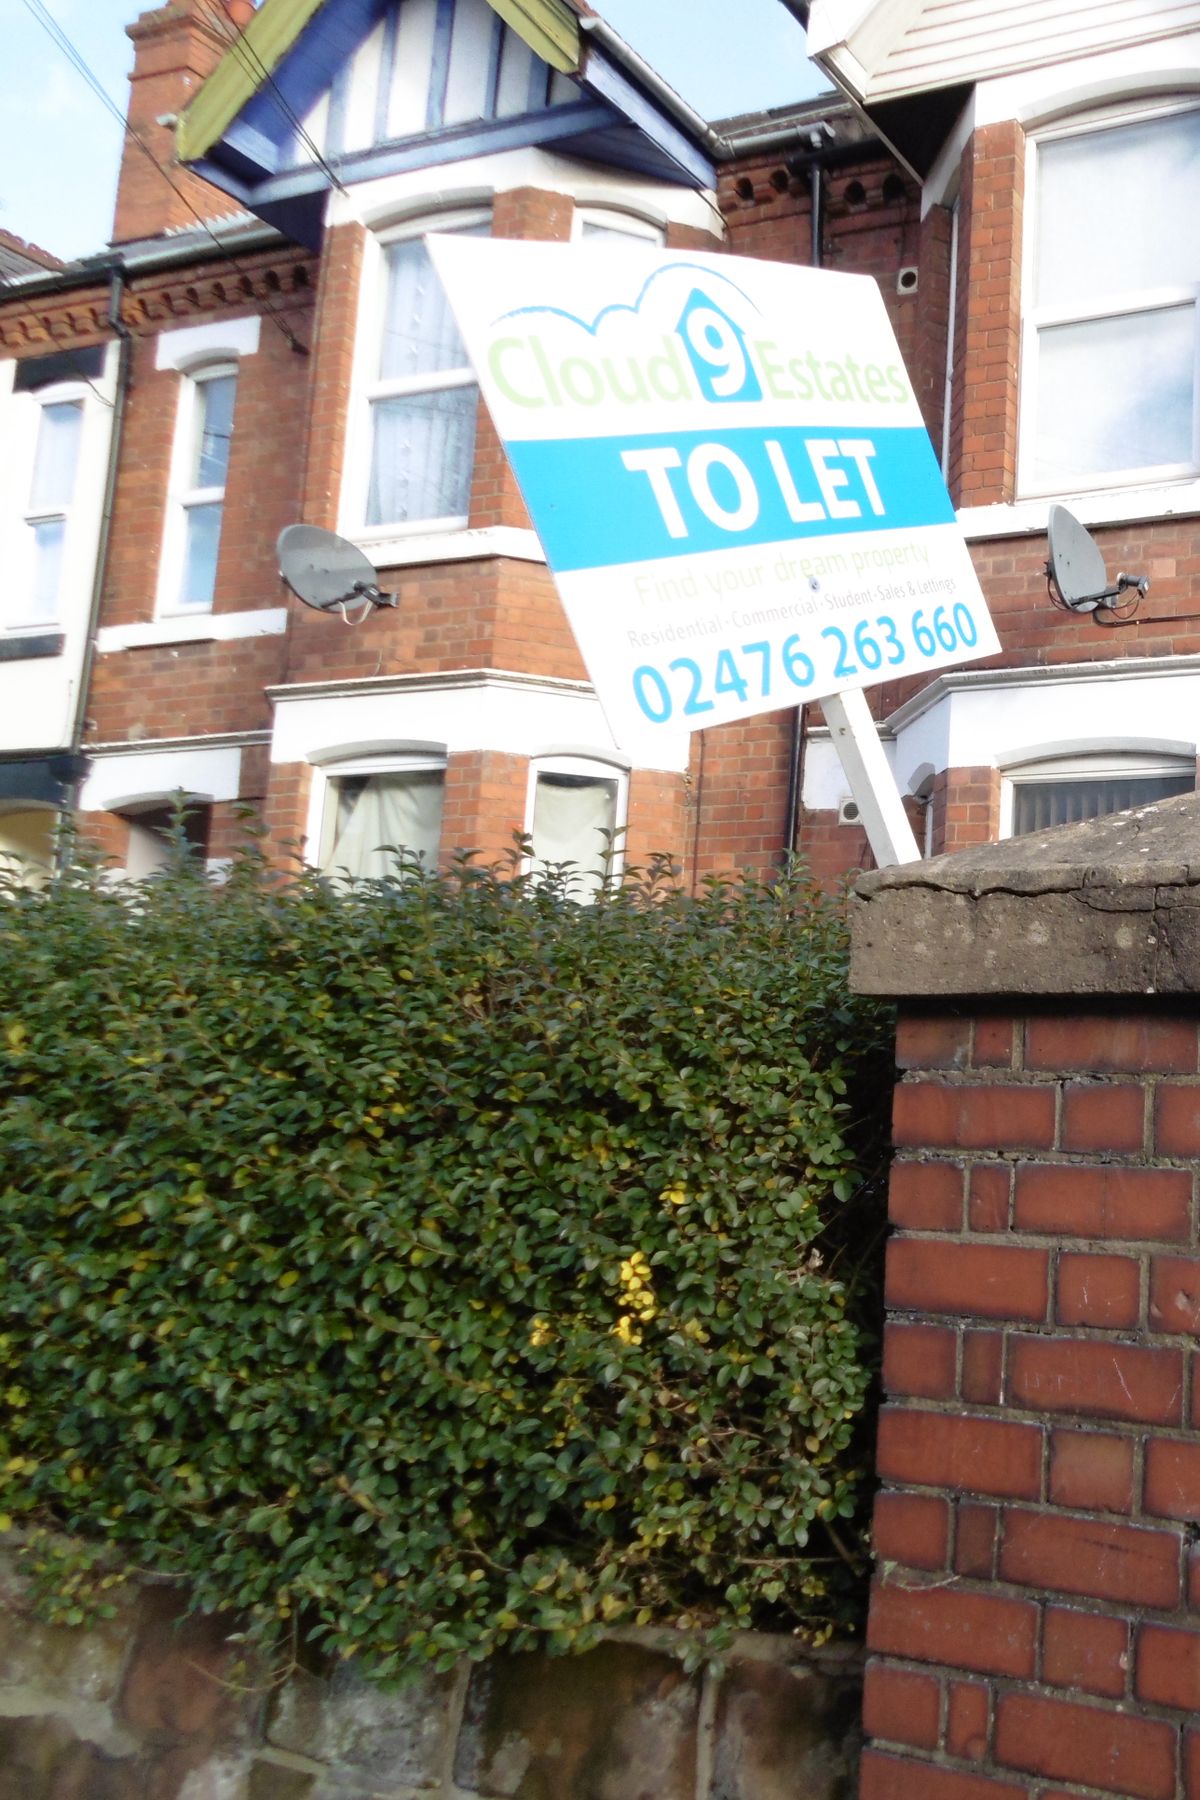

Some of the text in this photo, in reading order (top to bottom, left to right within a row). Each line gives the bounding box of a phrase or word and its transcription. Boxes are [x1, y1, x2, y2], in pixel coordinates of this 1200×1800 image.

[487, 306, 911, 409] Cloud 9 Estates
[620, 438, 886, 539] TO LET
[626, 575, 958, 649] Residential Commercial Student Sales & Lettings
[633, 541, 932, 608] Find your dream property
[631, 601, 979, 725] 02476 263 660
